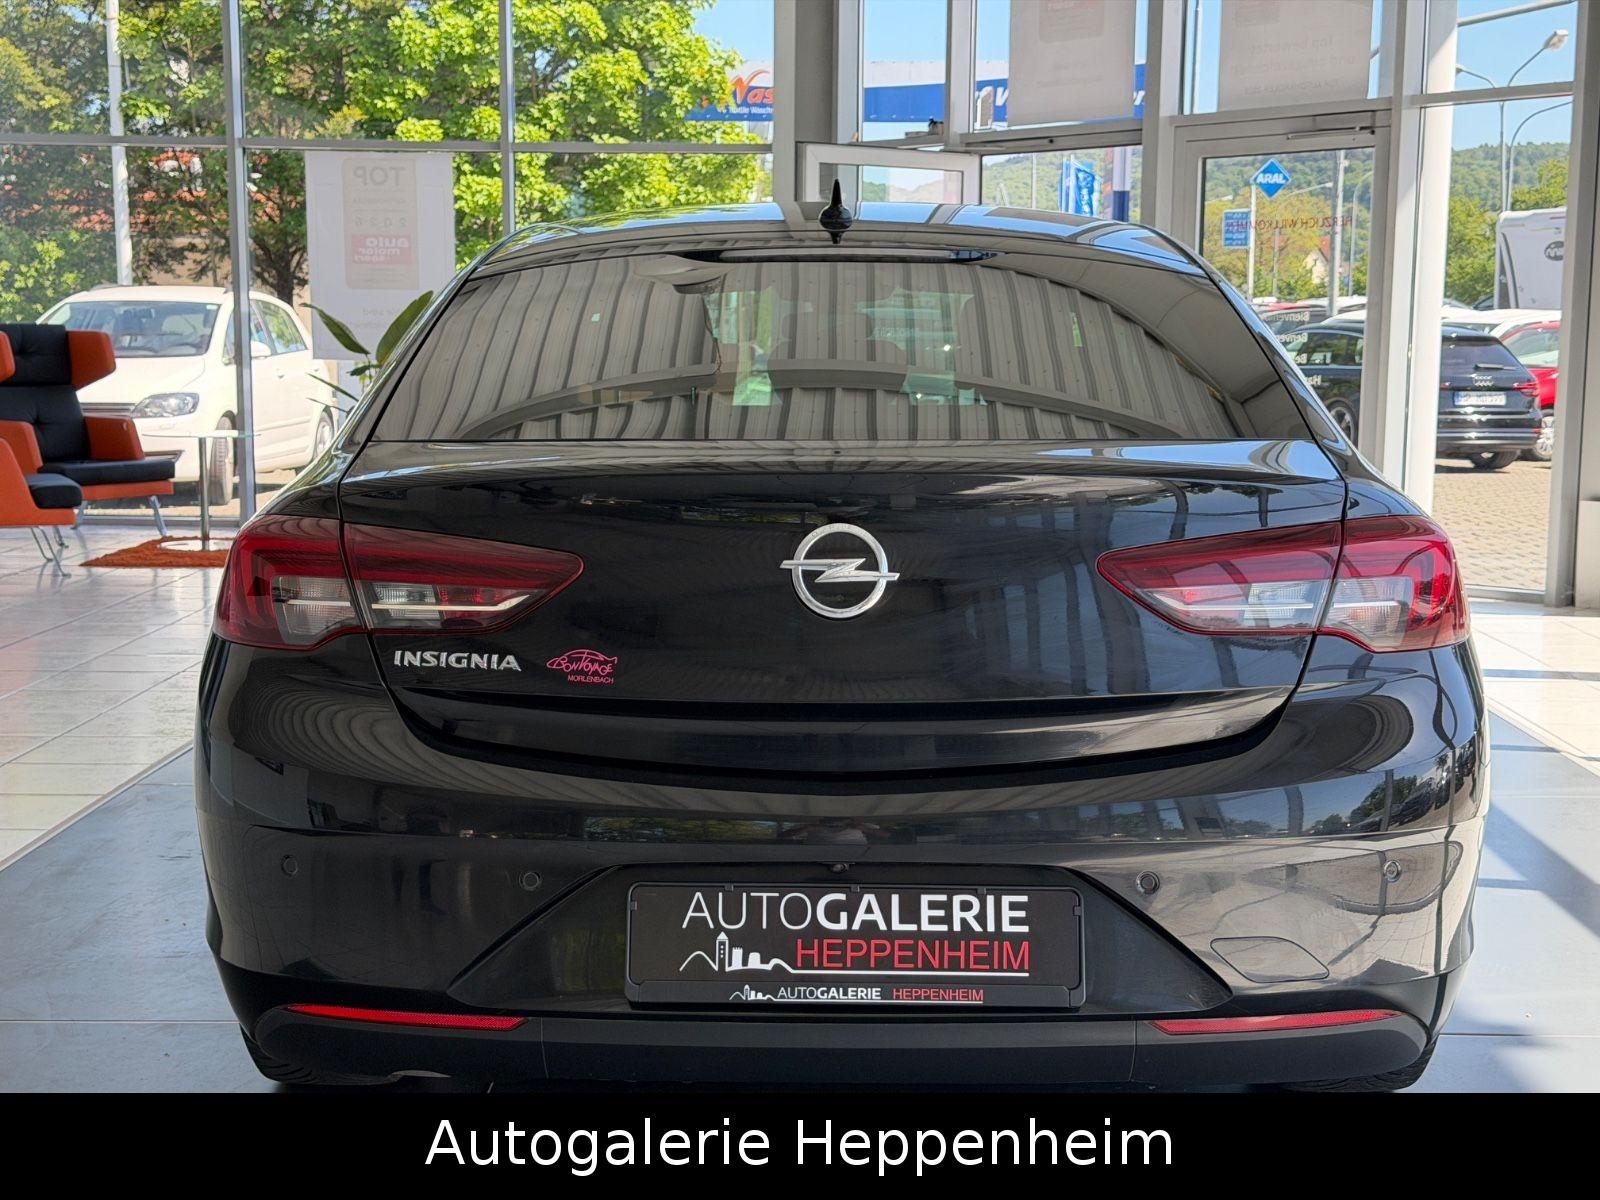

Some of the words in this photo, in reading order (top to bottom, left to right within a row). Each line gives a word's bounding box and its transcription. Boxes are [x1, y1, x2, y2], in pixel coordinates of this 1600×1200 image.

[1256, 173, 1286, 184] ARAL
[393, 650, 522, 672] INSIGNIA
[682, 891, 1030, 933] AUTOGALERIE
[795, 938, 1030, 970] HEPPENHEIM
[777, 986, 882, 1001] AUTOGALERIE
[892, 987, 984, 1002] HEPPENHEIM
